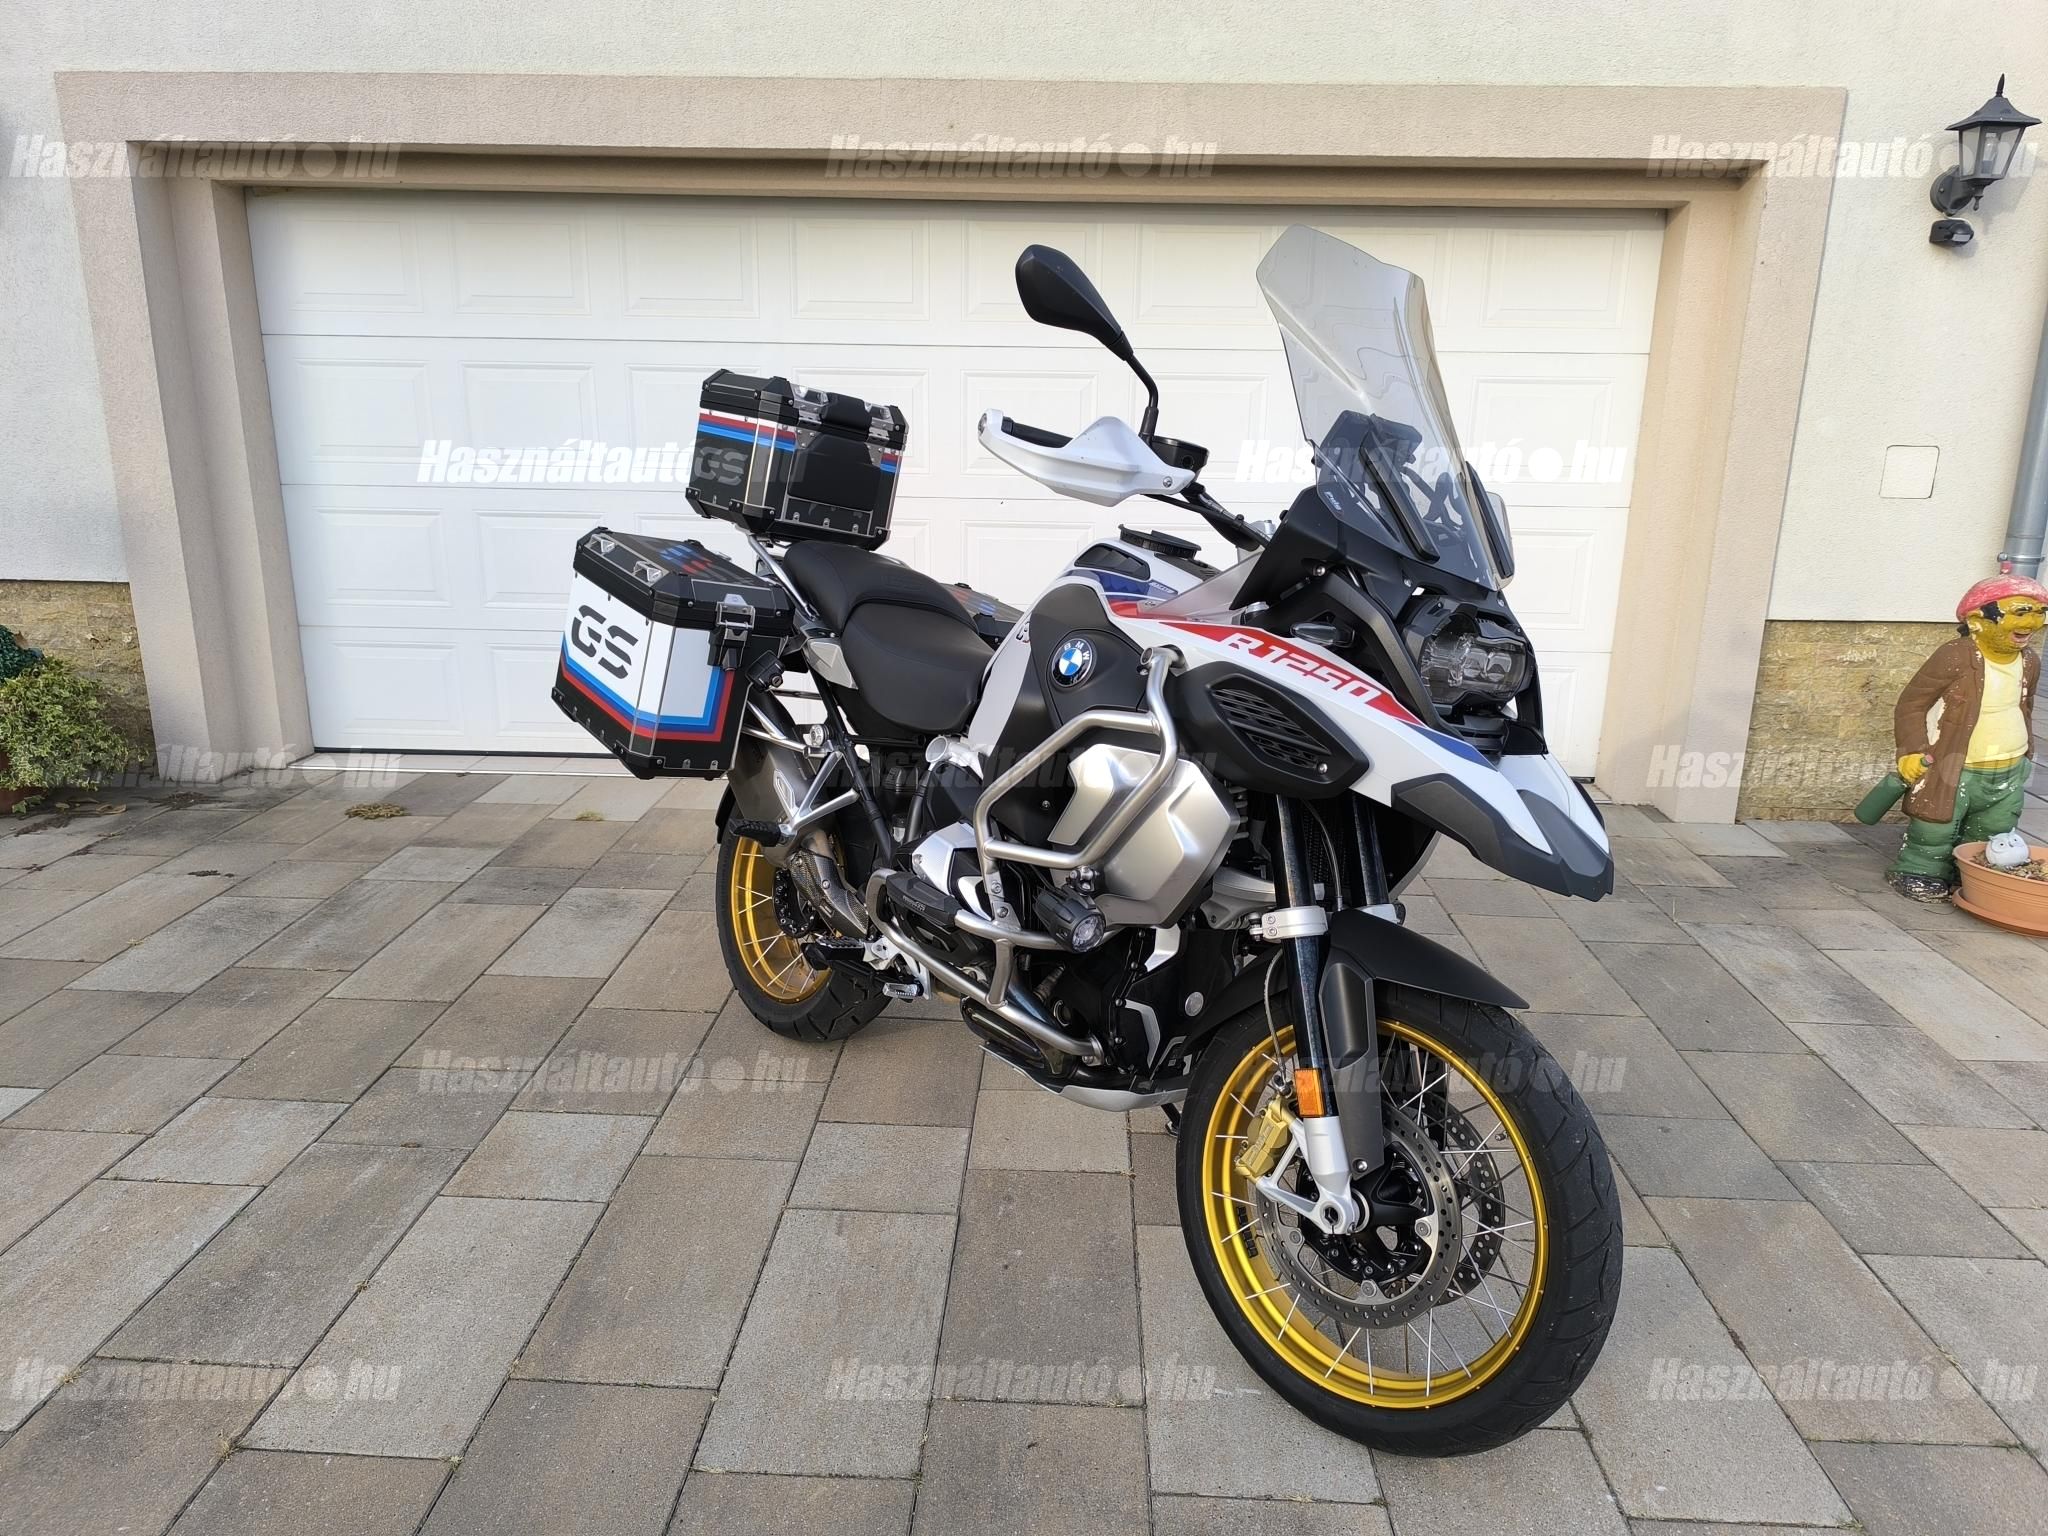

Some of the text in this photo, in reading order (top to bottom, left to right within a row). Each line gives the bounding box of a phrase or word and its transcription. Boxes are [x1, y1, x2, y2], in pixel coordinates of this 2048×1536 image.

[693, 446, 749, 487] GS
[571, 604, 639, 680] GS
[1063, 640, 1091, 661] BMW
